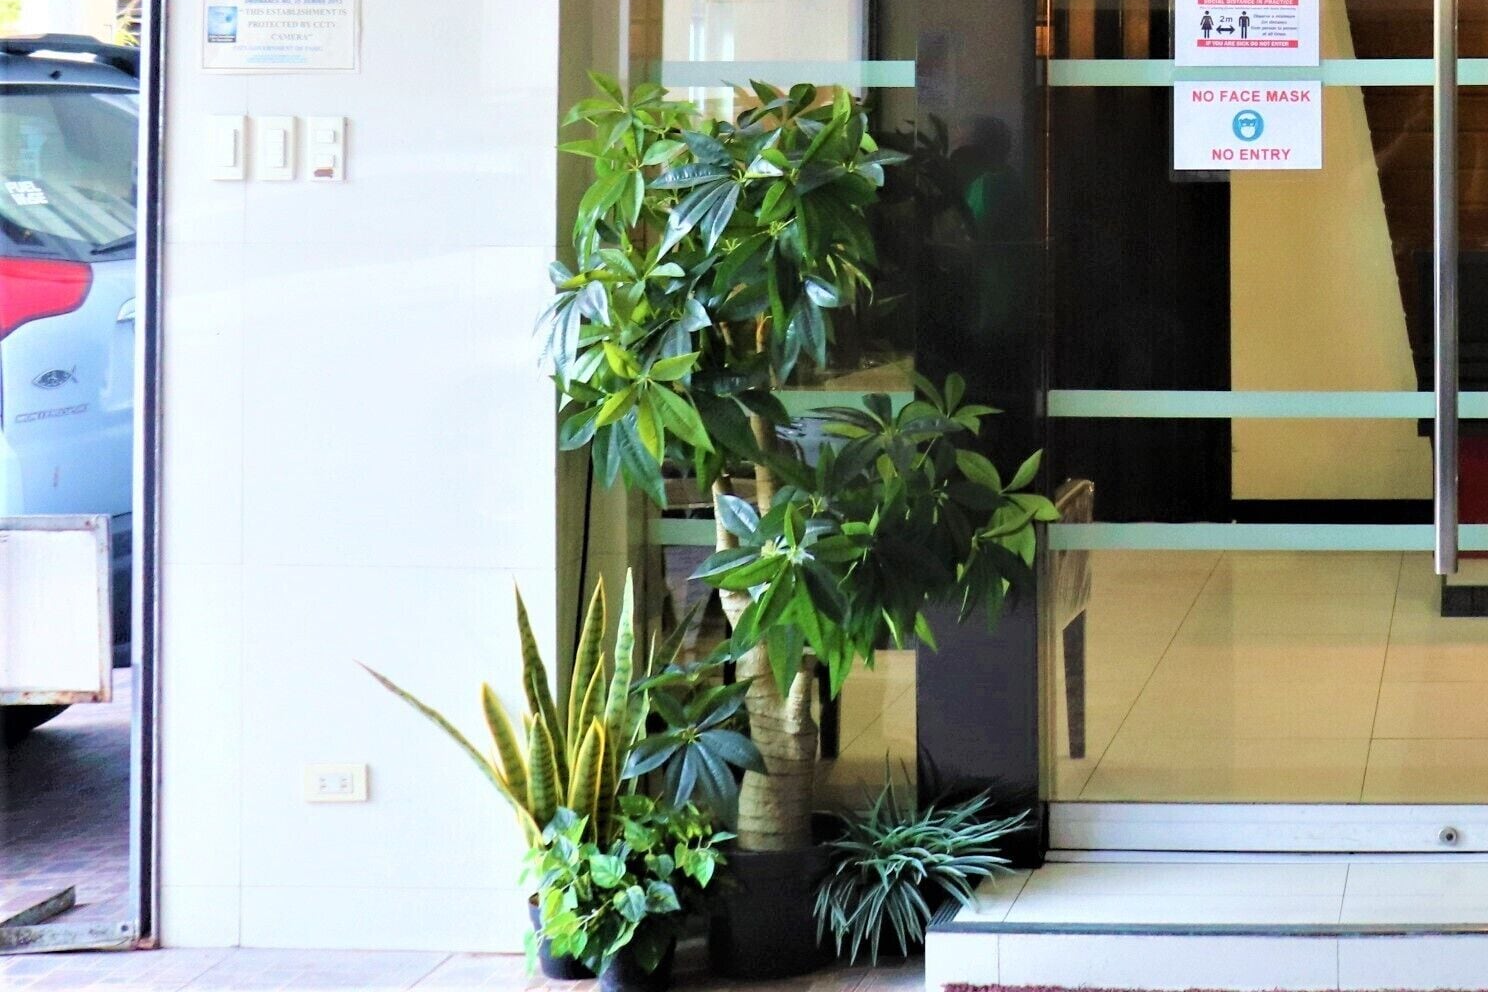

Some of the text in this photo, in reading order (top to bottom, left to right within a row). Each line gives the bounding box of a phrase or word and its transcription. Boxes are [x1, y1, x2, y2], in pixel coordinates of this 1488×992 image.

[1192, 90, 1311, 102] NO FACE MASK
[1212, 149, 1291, 161] NO ENTRY
